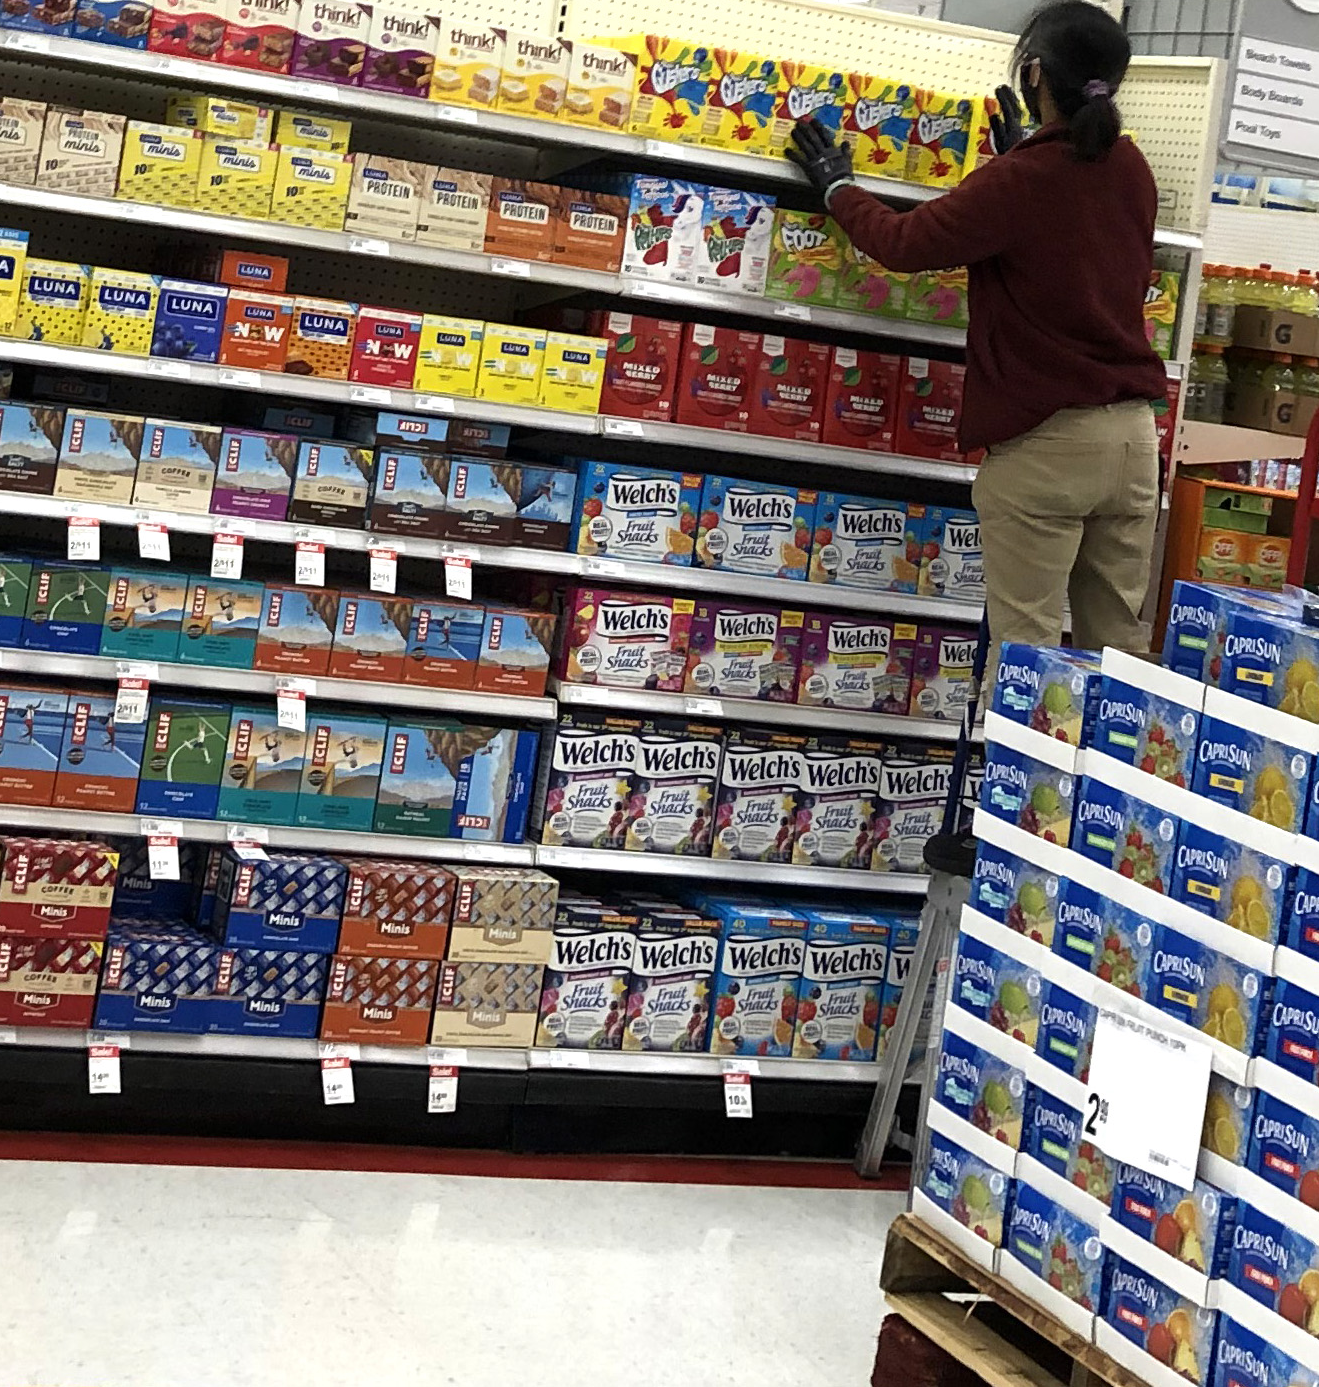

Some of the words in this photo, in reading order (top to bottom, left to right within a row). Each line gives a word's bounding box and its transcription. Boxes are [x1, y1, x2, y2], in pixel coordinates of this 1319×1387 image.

[314, 3, 362, 27] think!
[451, 28, 497, 49] think!
[63, 139, 101, 154] minis
[147, 143, 181, 157] minis
[367, 180, 410, 199] PROTEIN
[34, 280, 76, 295] LUNA
[172, 298, 214, 314] LUNA
[304, 315, 346, 332] LUNA
[1275, 324, 1293, 344] G
[623, 362, 660, 374] MIXED
[72, 420, 84, 444] CLIF
[612, 484, 676, 505] Welch's
[730, 497, 792, 518] Welch's
[626, 520, 655, 533] Fruit
[843, 513, 902, 533] Welch's
[616, 529, 659, 543] Snacks
[603, 609, 668, 631] Welch's
[833, 629, 887, 648] Welch's
[615, 646, 645, 659] Fruit
[605, 656, 649, 670] Snacks
[562, 714, 573, 722] 22
[156, 713, 170, 744] CLIF
[560, 739, 634, 765] Welch's
[642, 746, 716, 771] Welch's
[729, 755, 800, 781] Welch's
[578, 784, 609, 796] Fruit
[566, 795, 612, 810] Snacks
[14, 854, 28, 882] CLIF
[351, 877, 363, 904] CLIF
[269, 914, 299, 927] Minis
[381, 922, 410, 935] Minis
[556, 937, 631, 965] Welch's
[730, 942, 801, 969] Welch's
[811, 947, 883, 975] Welch's
[572, 982, 604, 997] Fruit
[140, 996, 171, 1008] Minis
[562, 997, 608, 1010] Snacks
